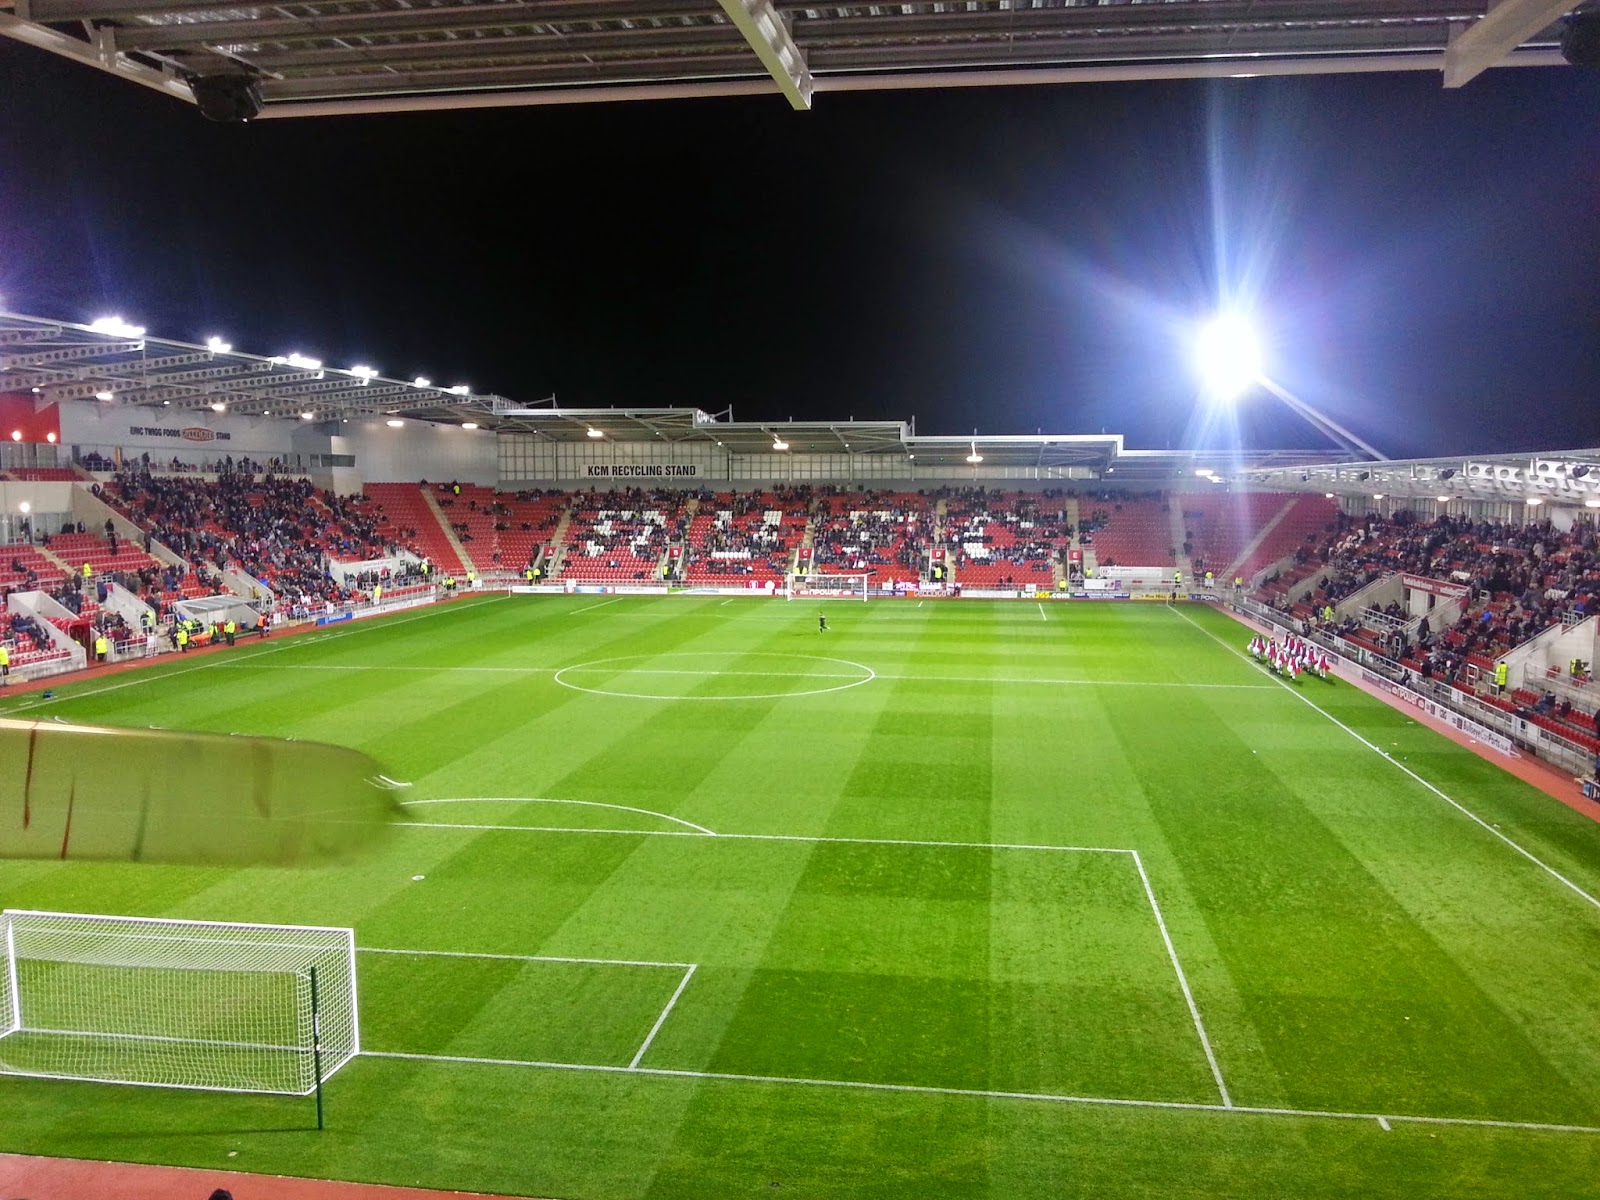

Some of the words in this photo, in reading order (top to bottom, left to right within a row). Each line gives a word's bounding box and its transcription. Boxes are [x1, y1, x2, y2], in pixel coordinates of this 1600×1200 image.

[163, 428, 180, 438] FOODS
[216, 431, 231, 440] STAND
[587, 465, 609, 476] KCM
[612, 465, 662, 476] RECYCLING
[665, 465, 696, 476] STAND
[1397, 687, 1419, 705] npower
